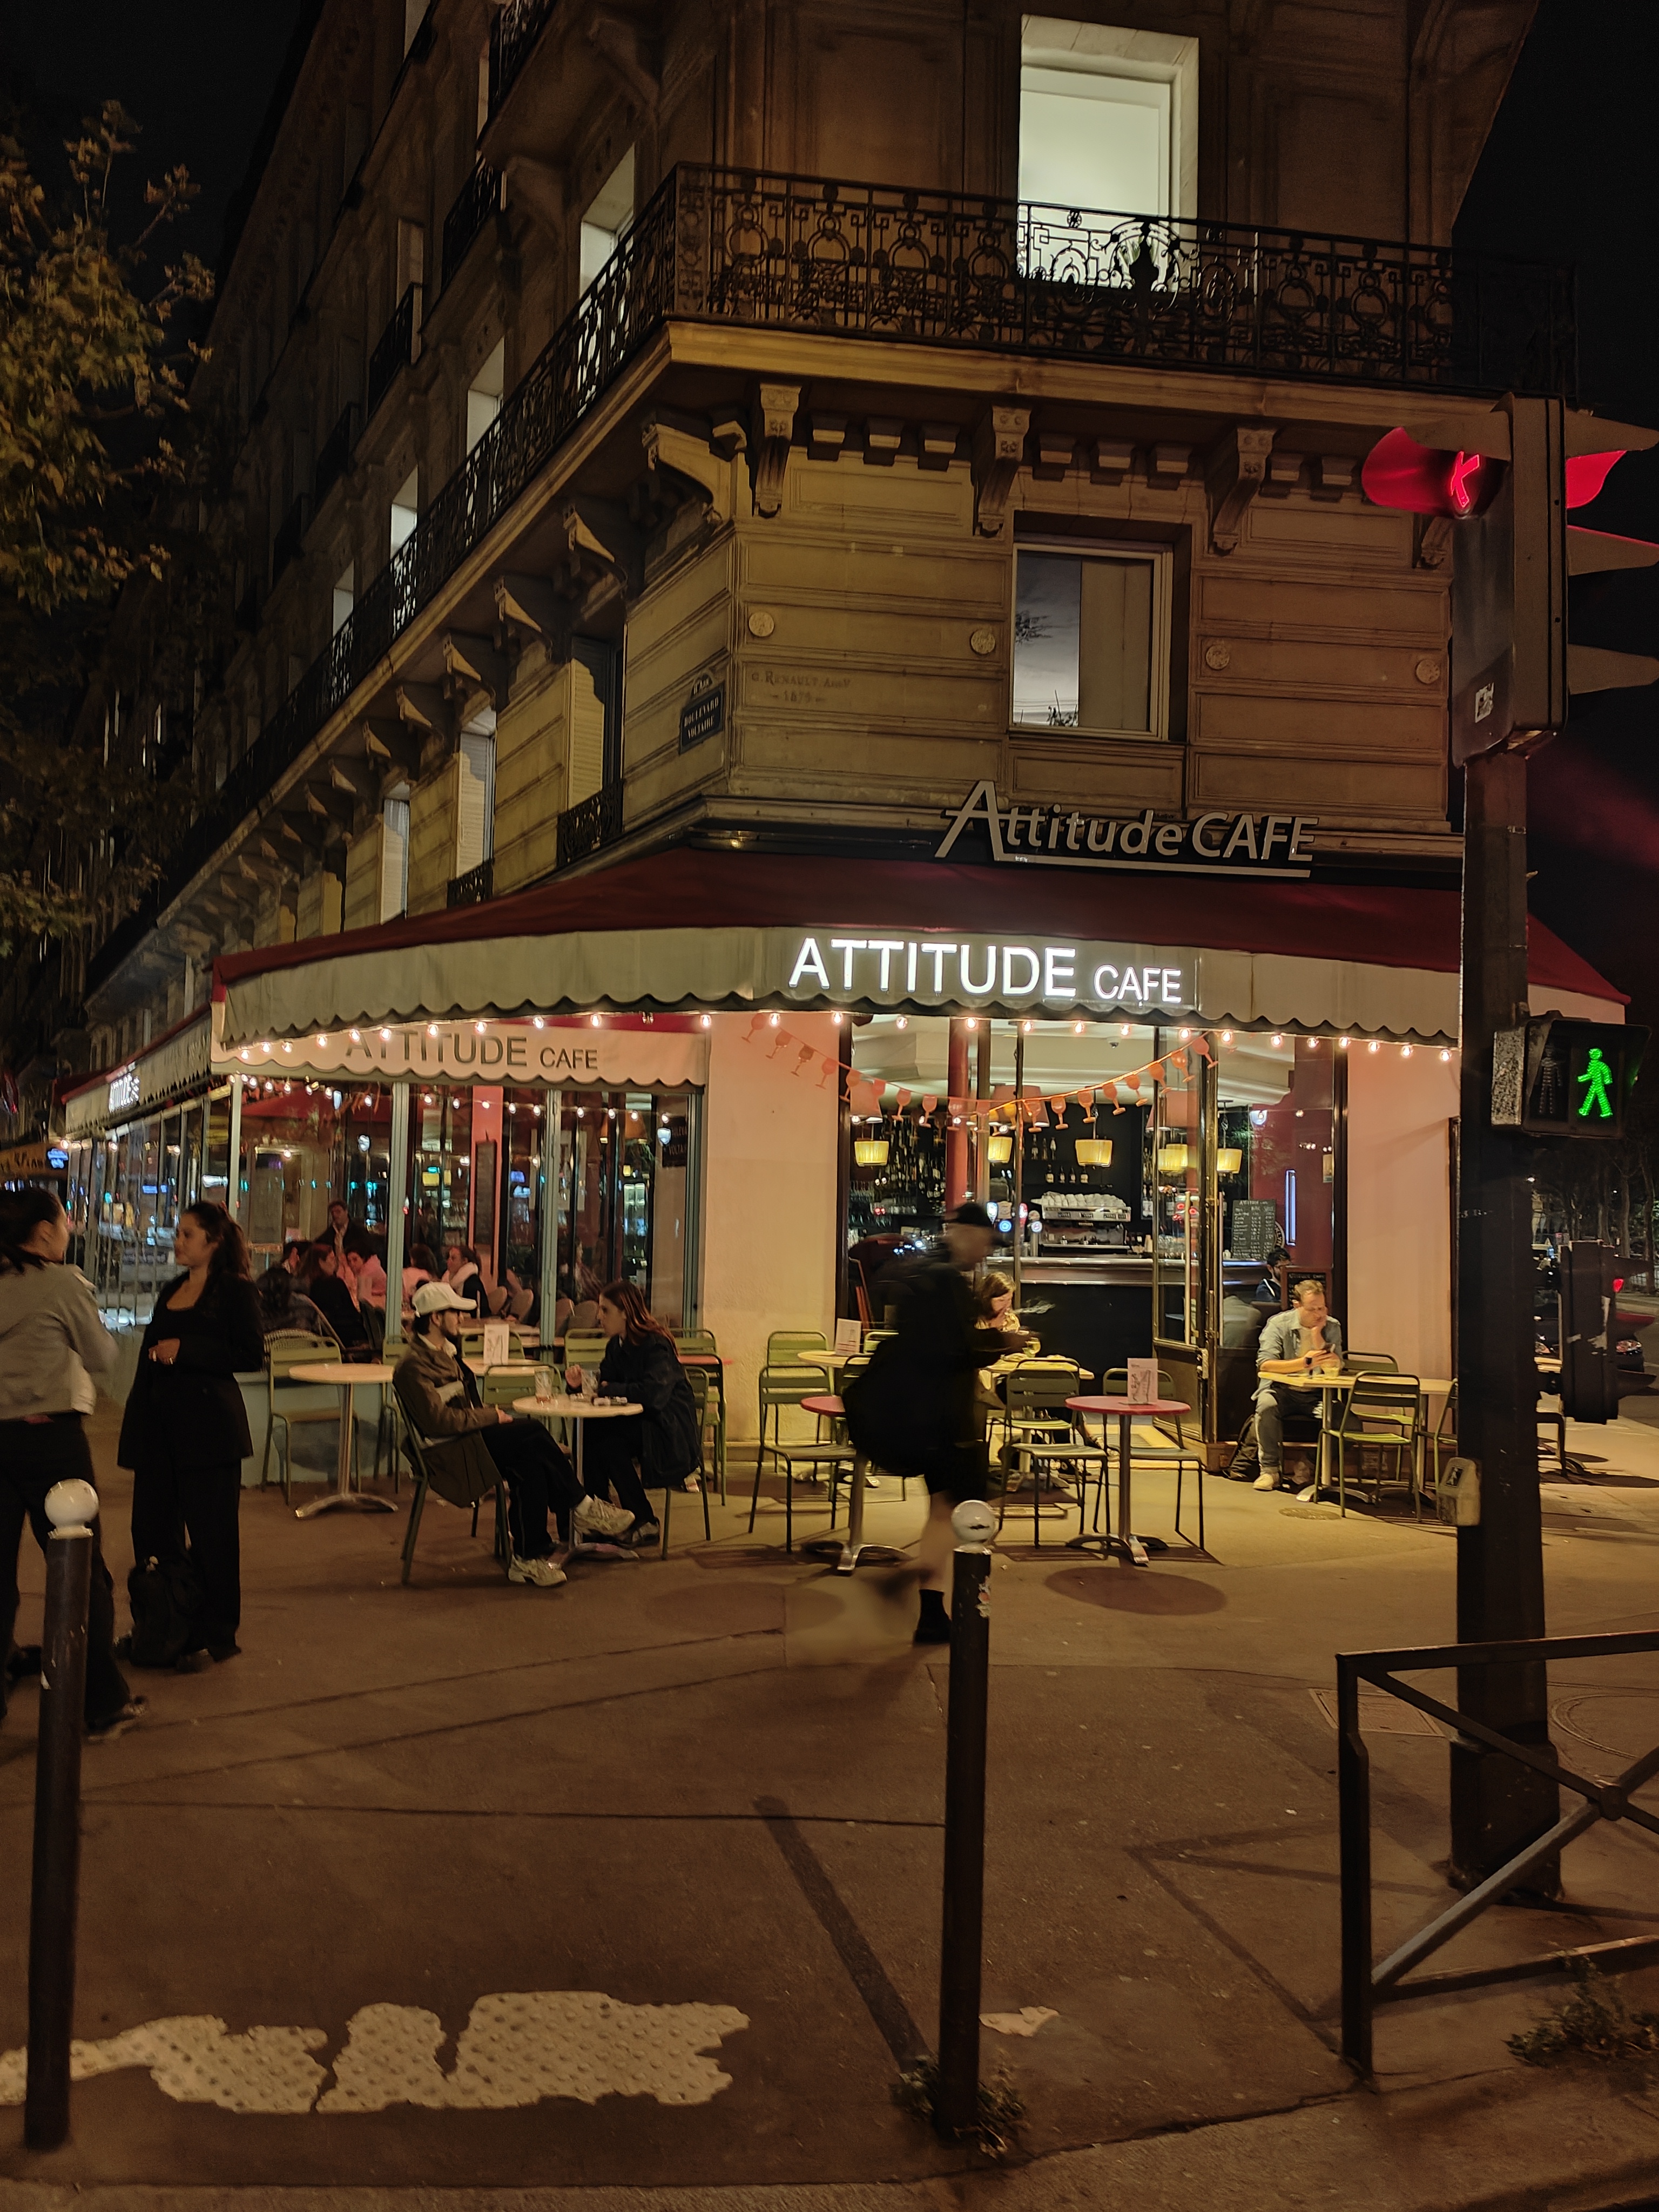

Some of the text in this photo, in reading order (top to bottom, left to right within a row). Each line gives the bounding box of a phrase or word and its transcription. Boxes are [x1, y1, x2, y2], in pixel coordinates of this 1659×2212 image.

[684, 696, 719, 727] BOULEVARD
[687, 714, 715, 739] VOLTAIRE
[935, 780, 1319, 862] Attitude CAFE
[789, 937, 1182, 1003] ATTITUDE CAFE
[346, 1030, 598, 1069] ATTITUDE CAFE
